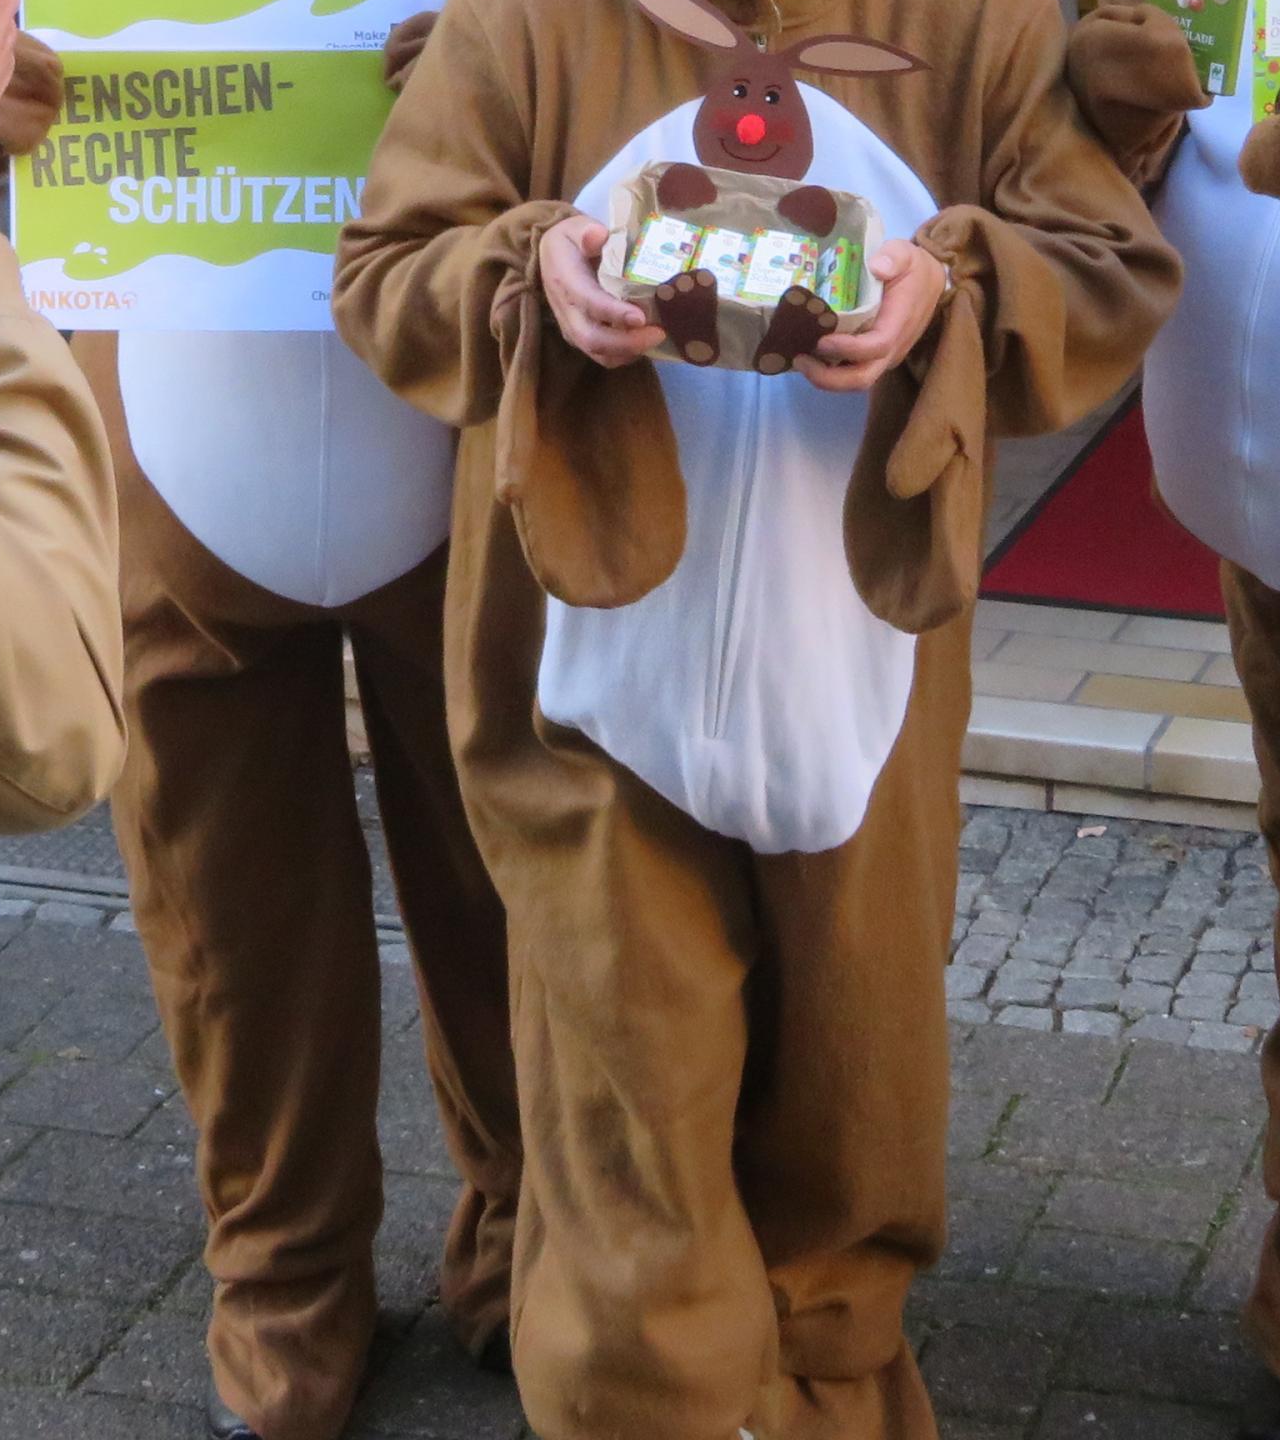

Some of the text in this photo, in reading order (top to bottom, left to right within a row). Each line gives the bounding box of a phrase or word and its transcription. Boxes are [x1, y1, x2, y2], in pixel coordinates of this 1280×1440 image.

[54, 62, 294, 126] ENSCHEN-
[31, 127, 201, 188] RECHTE
[108, 166, 366, 224] SCHÜTZEN
[31, 290, 121, 311] INKOTA
